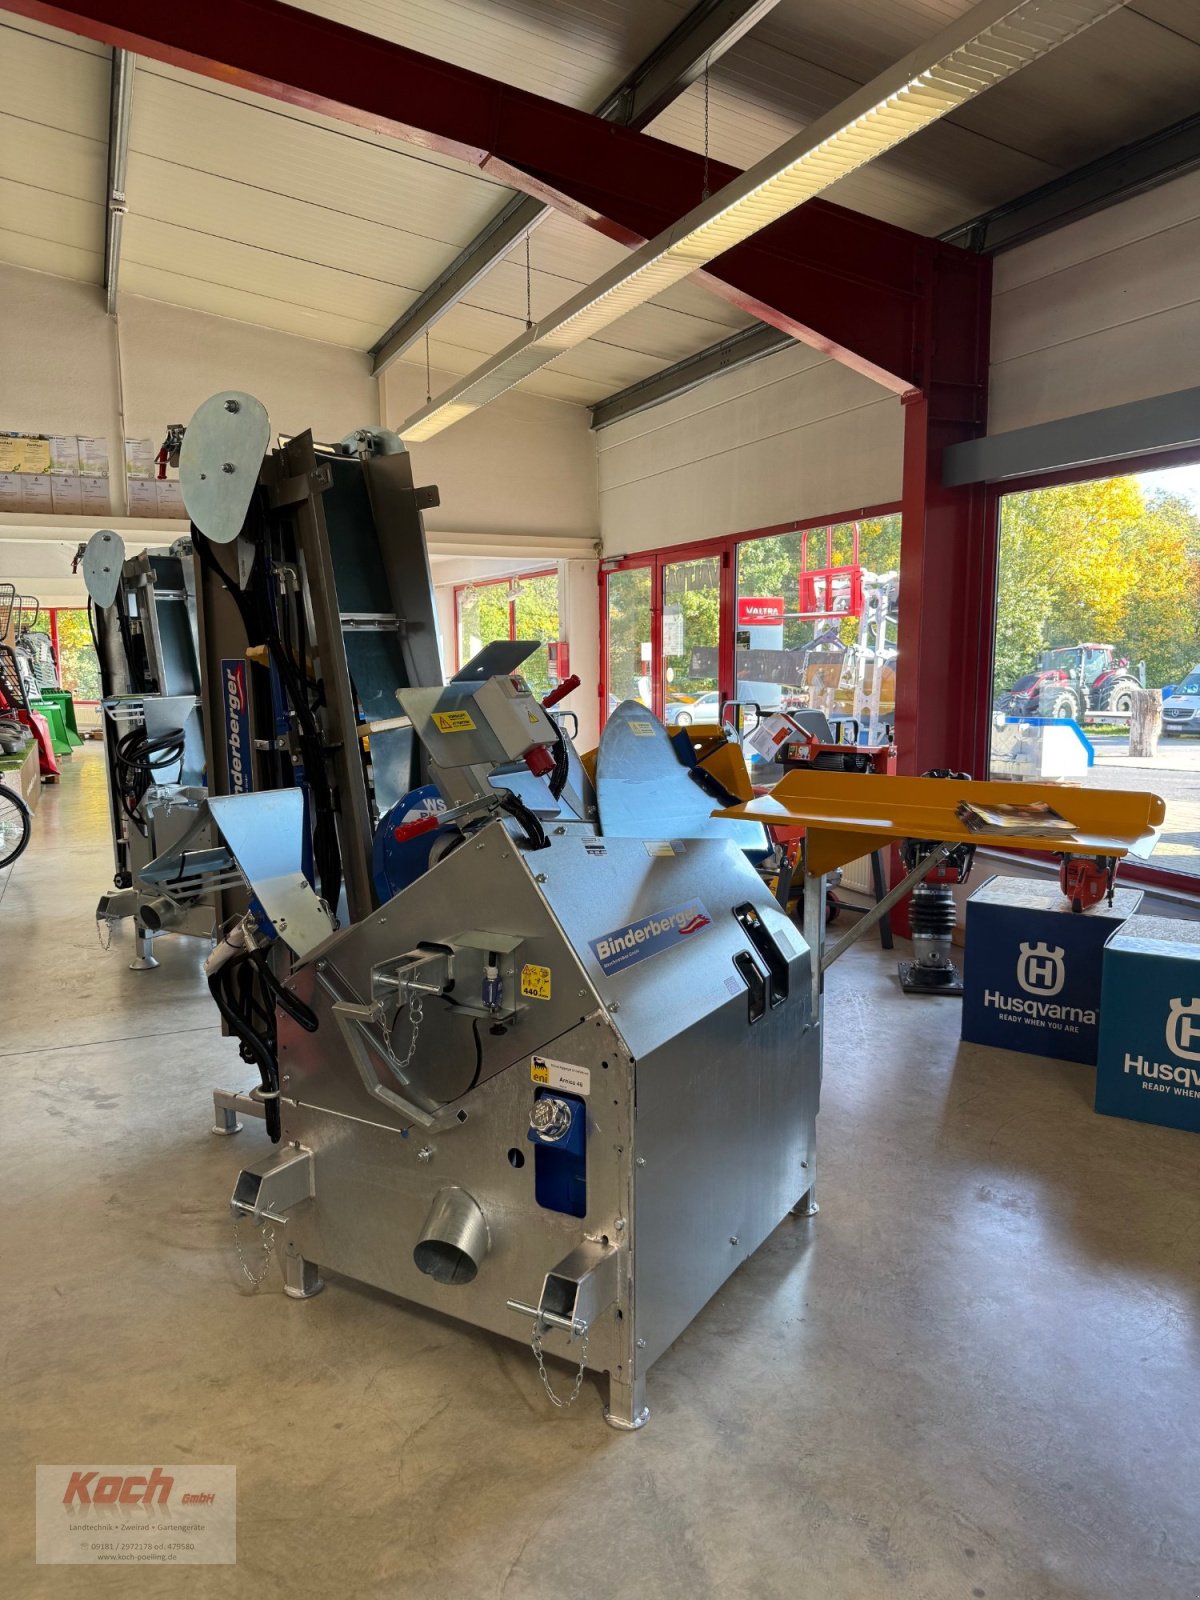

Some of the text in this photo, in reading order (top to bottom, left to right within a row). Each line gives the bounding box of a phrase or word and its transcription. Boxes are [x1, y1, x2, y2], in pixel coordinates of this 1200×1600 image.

[745, 606, 779, 615] VALTRA
[422, 798, 448, 812] WS
[523, 987, 538, 996] 440
[984, 989, 1096, 1024] Husqvarna
[998, 1013, 1080, 1034] READY WHEN YOU ARE
[533, 1073, 548, 1084] eni
[1142, 1081, 1200, 1099] READY WHEN
